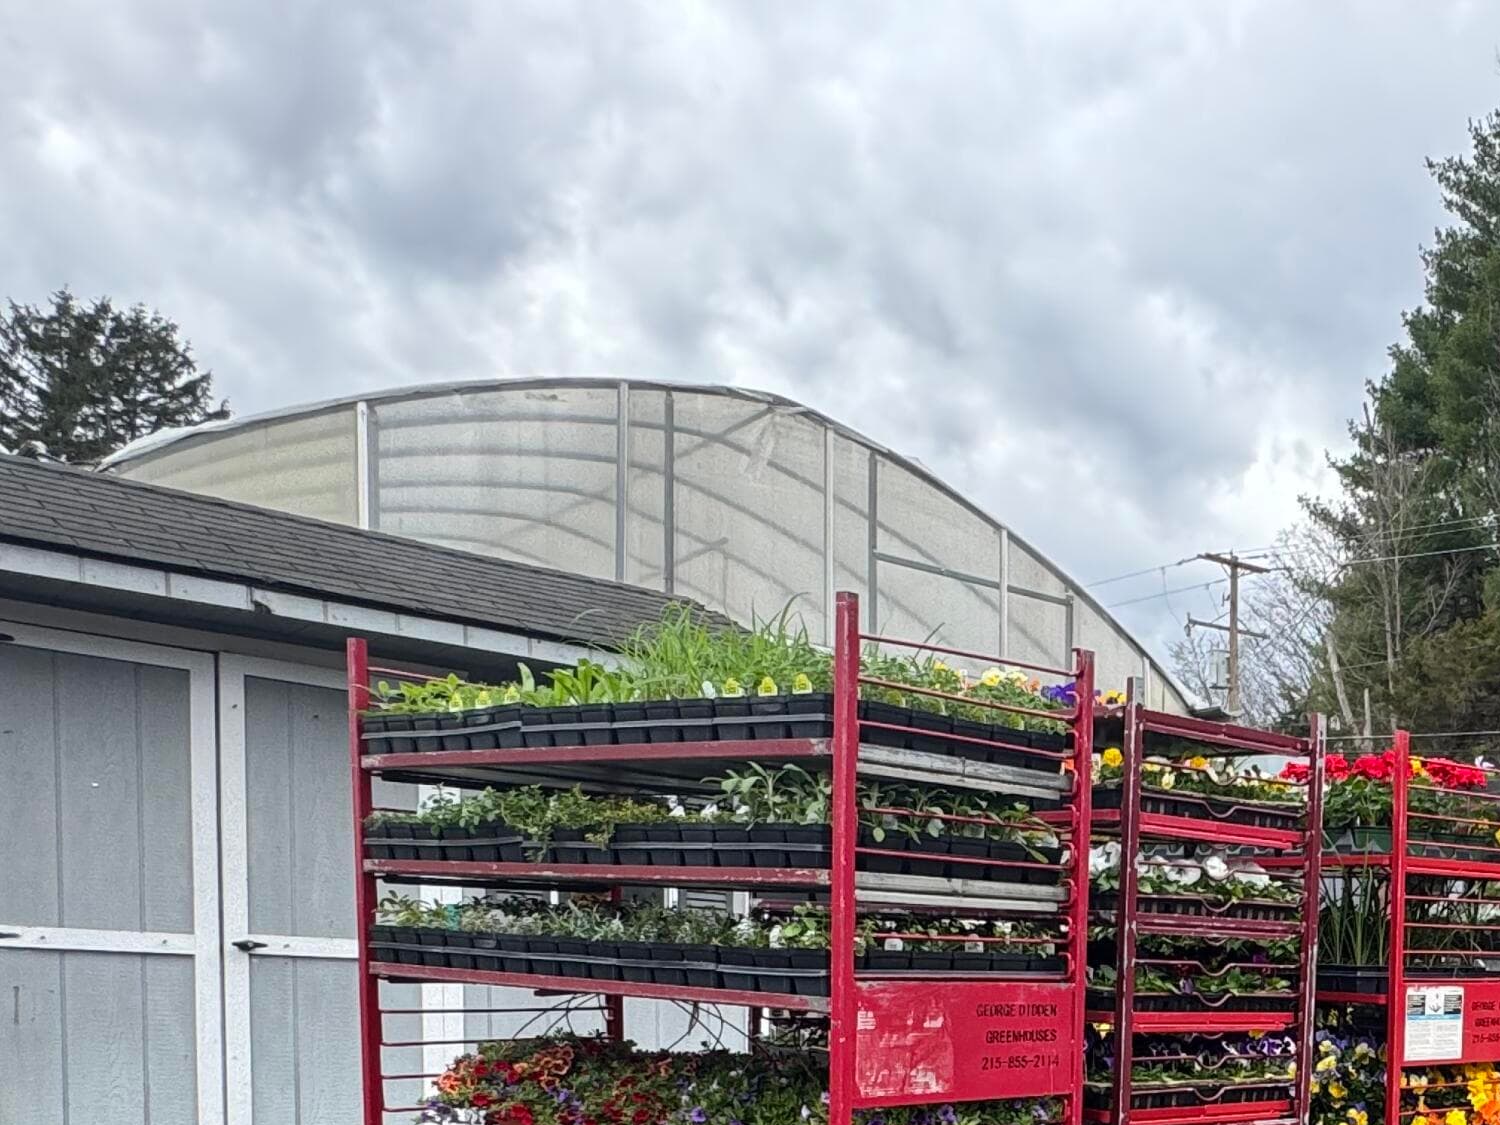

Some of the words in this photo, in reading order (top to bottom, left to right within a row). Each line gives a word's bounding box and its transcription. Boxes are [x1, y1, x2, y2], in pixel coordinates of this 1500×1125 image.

[976, 1003, 1015, 1017] GEORGE
[1018, 1003, 1057, 1017] DIDDEN
[985, 1028, 1057, 1044] GREENHOUSES
[982, 1054, 1059, 1071] 215-855-2114
